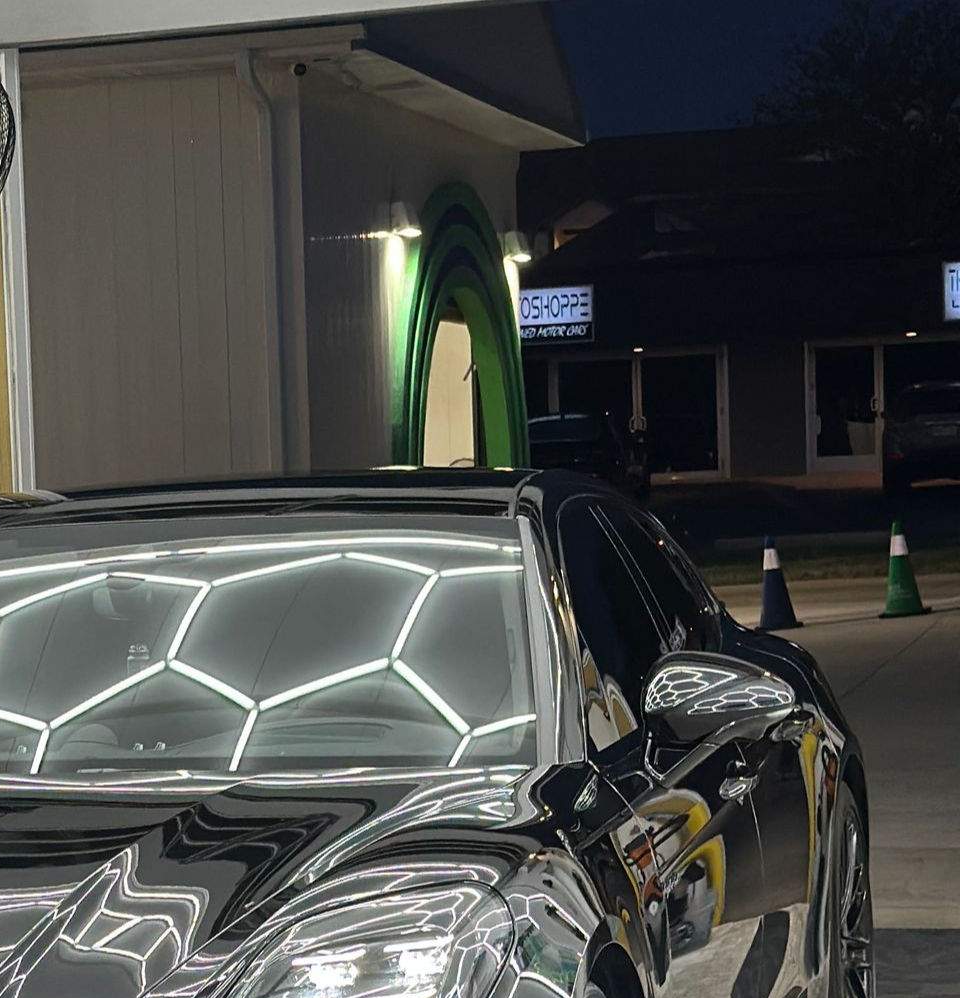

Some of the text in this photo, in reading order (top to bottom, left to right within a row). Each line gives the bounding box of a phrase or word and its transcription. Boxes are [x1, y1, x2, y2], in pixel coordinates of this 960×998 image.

[520, 293, 589, 320] OSHOPPE
[537, 325, 566, 337] MOTOR
[567, 323, 589, 336] CARS
